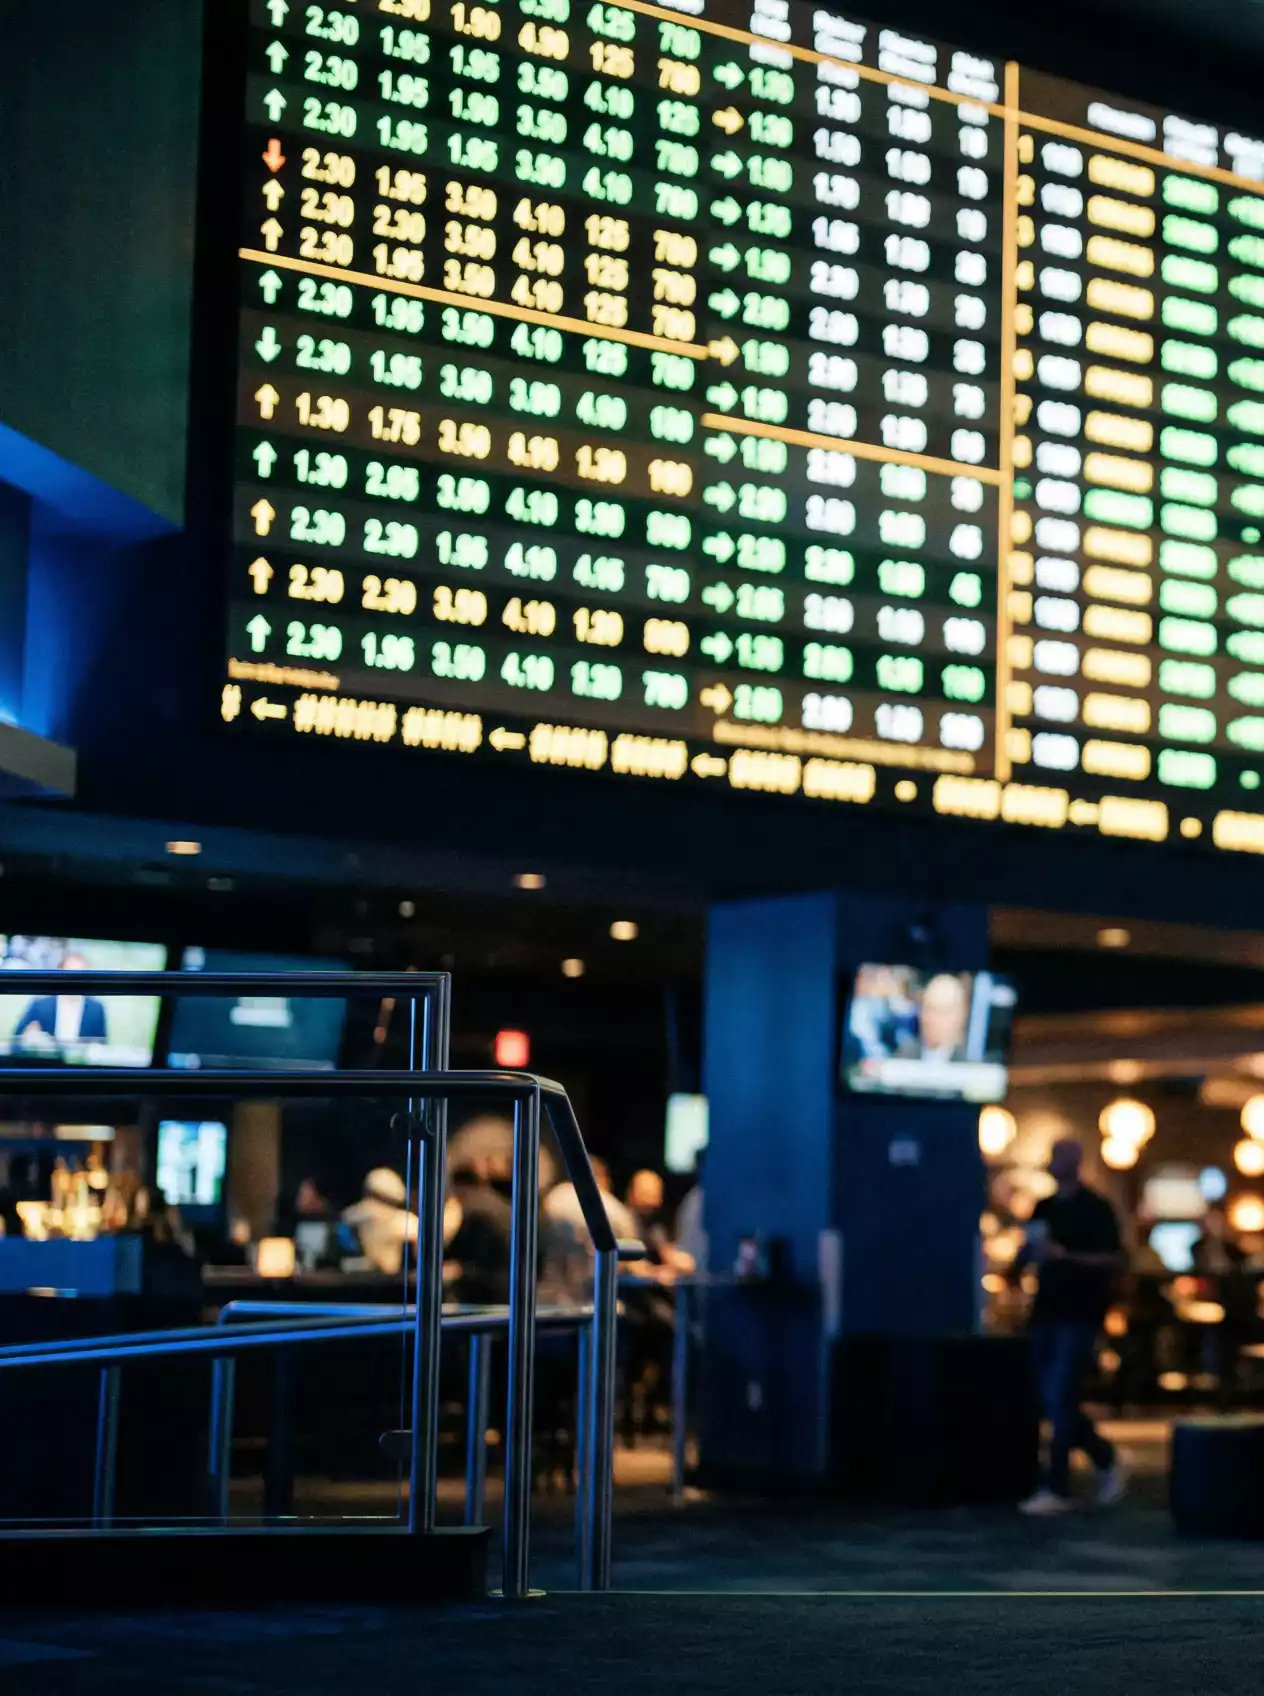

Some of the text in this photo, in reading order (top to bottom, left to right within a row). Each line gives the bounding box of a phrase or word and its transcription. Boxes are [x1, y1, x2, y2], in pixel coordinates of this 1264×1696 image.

[306, 6, 359, 45] 2.30
[380, 26, 430, 64] 1.95
[450, 45, 499, 83] 1.95
[584, 81, 634, 119] 4.10
[304, 51, 358, 90] 2.30
[378, 70, 428, 108] 1.95
[517, 105, 567, 143] 3.50
[583, 123, 633, 161] 4.10
[302, 148, 355, 187] 2.30
[376, 166, 426, 204] 1.95
[513, 198, 565, 236] 4.10
[303, 97, 356, 137] 2.30
[377, 116, 427, 154] 1.95
[583, 167, 632, 204] 4.10
[300, 227, 353, 266] 2.30
[511, 275, 563, 313] 4.10
[301, 188, 354, 227] 2.30
[373, 205, 425, 244] 2.30
[513, 237, 564, 276] 4.10
[296, 335, 351, 374] 2.30
[298, 278, 352, 317] 2.30
[372, 294, 424, 333] 1.95
[511, 323, 562, 362] 4.10
[296, 393, 349, 432] 1.30
[368, 406, 420, 445] 1.75
[294, 449, 348, 488] 1.30
[291, 506, 345, 546] 2.30
[364, 519, 418, 558] 2.30
[289, 564, 344, 603] 2.30
[362, 575, 416, 614] 2.30
[287, 621, 342, 660] 2.30
